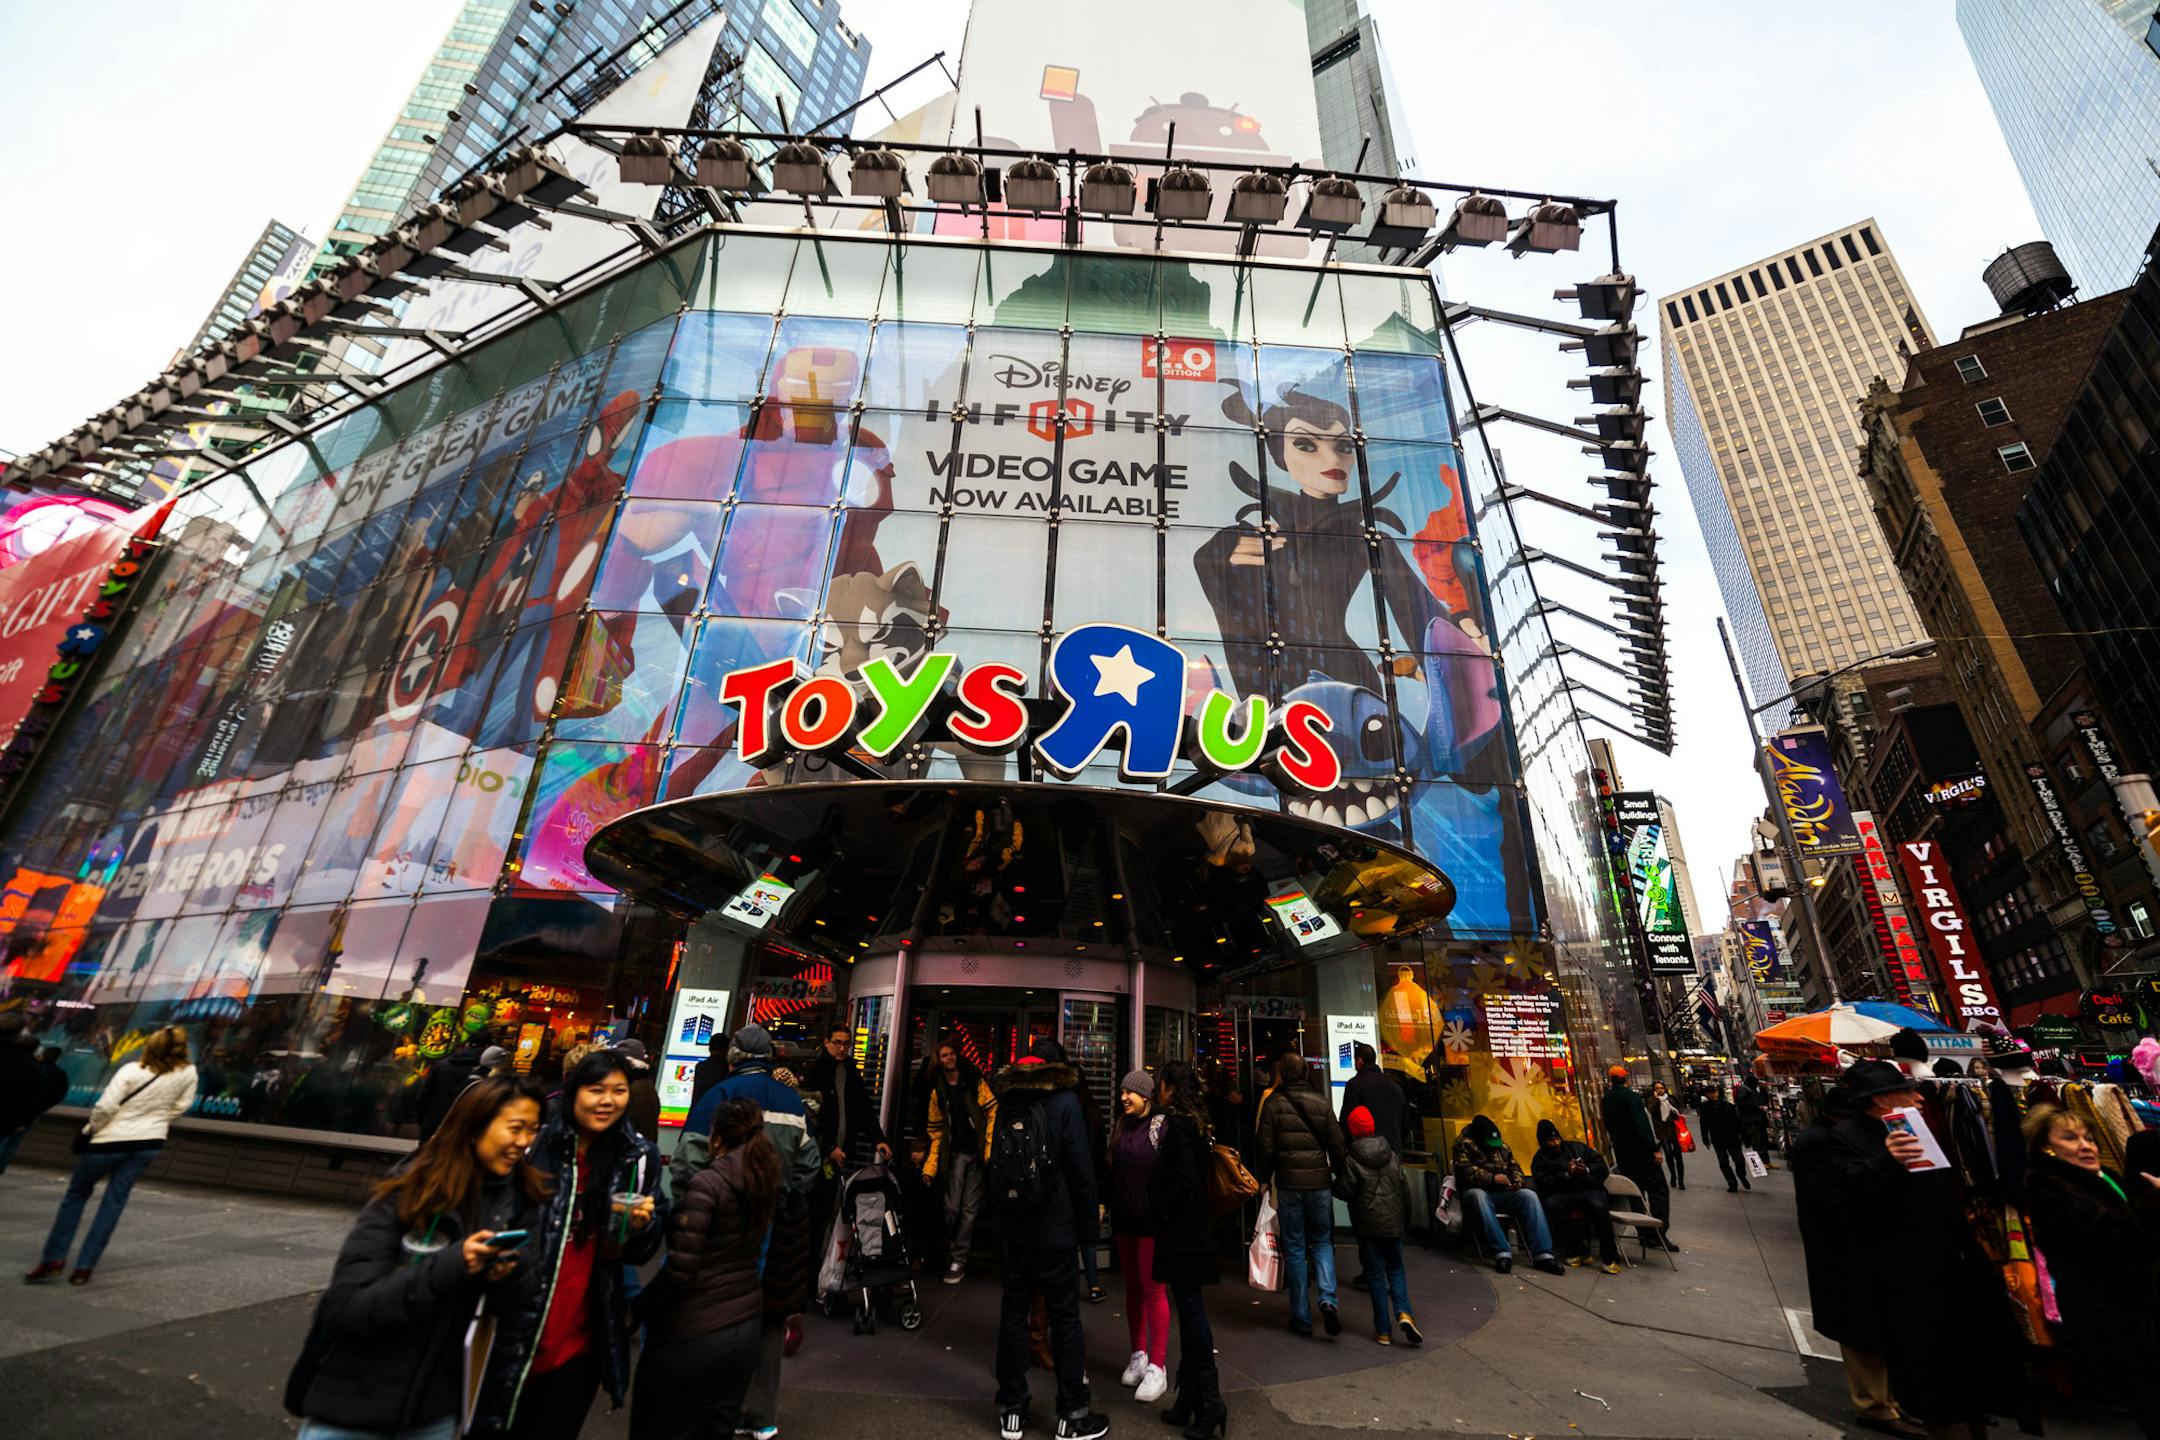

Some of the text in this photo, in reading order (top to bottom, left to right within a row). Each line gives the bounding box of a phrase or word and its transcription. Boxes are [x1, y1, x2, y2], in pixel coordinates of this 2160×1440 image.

[1147, 344, 1213, 371] 2.0
[1159, 368, 1202, 378] DITION
[988, 353, 1132, 406] Disney
[340, 374, 604, 507] ONE GREAT GAME
[926, 451, 1189, 490] VIDEO GAME
[928, 487, 1180, 519] NOW AVAILABLE
[2, 562, 110, 639] GIFT
[1924, 775, 1986, 804] VIRGIL'S
[1623, 800, 1649, 809] Smart
[1619, 811, 1659, 820] Buildings
[1857, 821, 1893, 881] PARK
[1906, 842, 1989, 1006] VIRGILS
[1648, 933, 1686, 943] Connect
[1658, 944, 1680, 953] with
[1890, 915, 1928, 981] PARK
[1653, 954, 1690, 965] Tenants
[688, 995, 719, 1004] iPad Air
[2091, 994, 2124, 1005] Deli
[1959, 1006, 2000, 1017] BBQ
[2098, 1012, 2133, 1024] Café
[1337, 1021, 1366, 1030] iPad Air
[1926, 1037, 1974, 1049] TITAN
